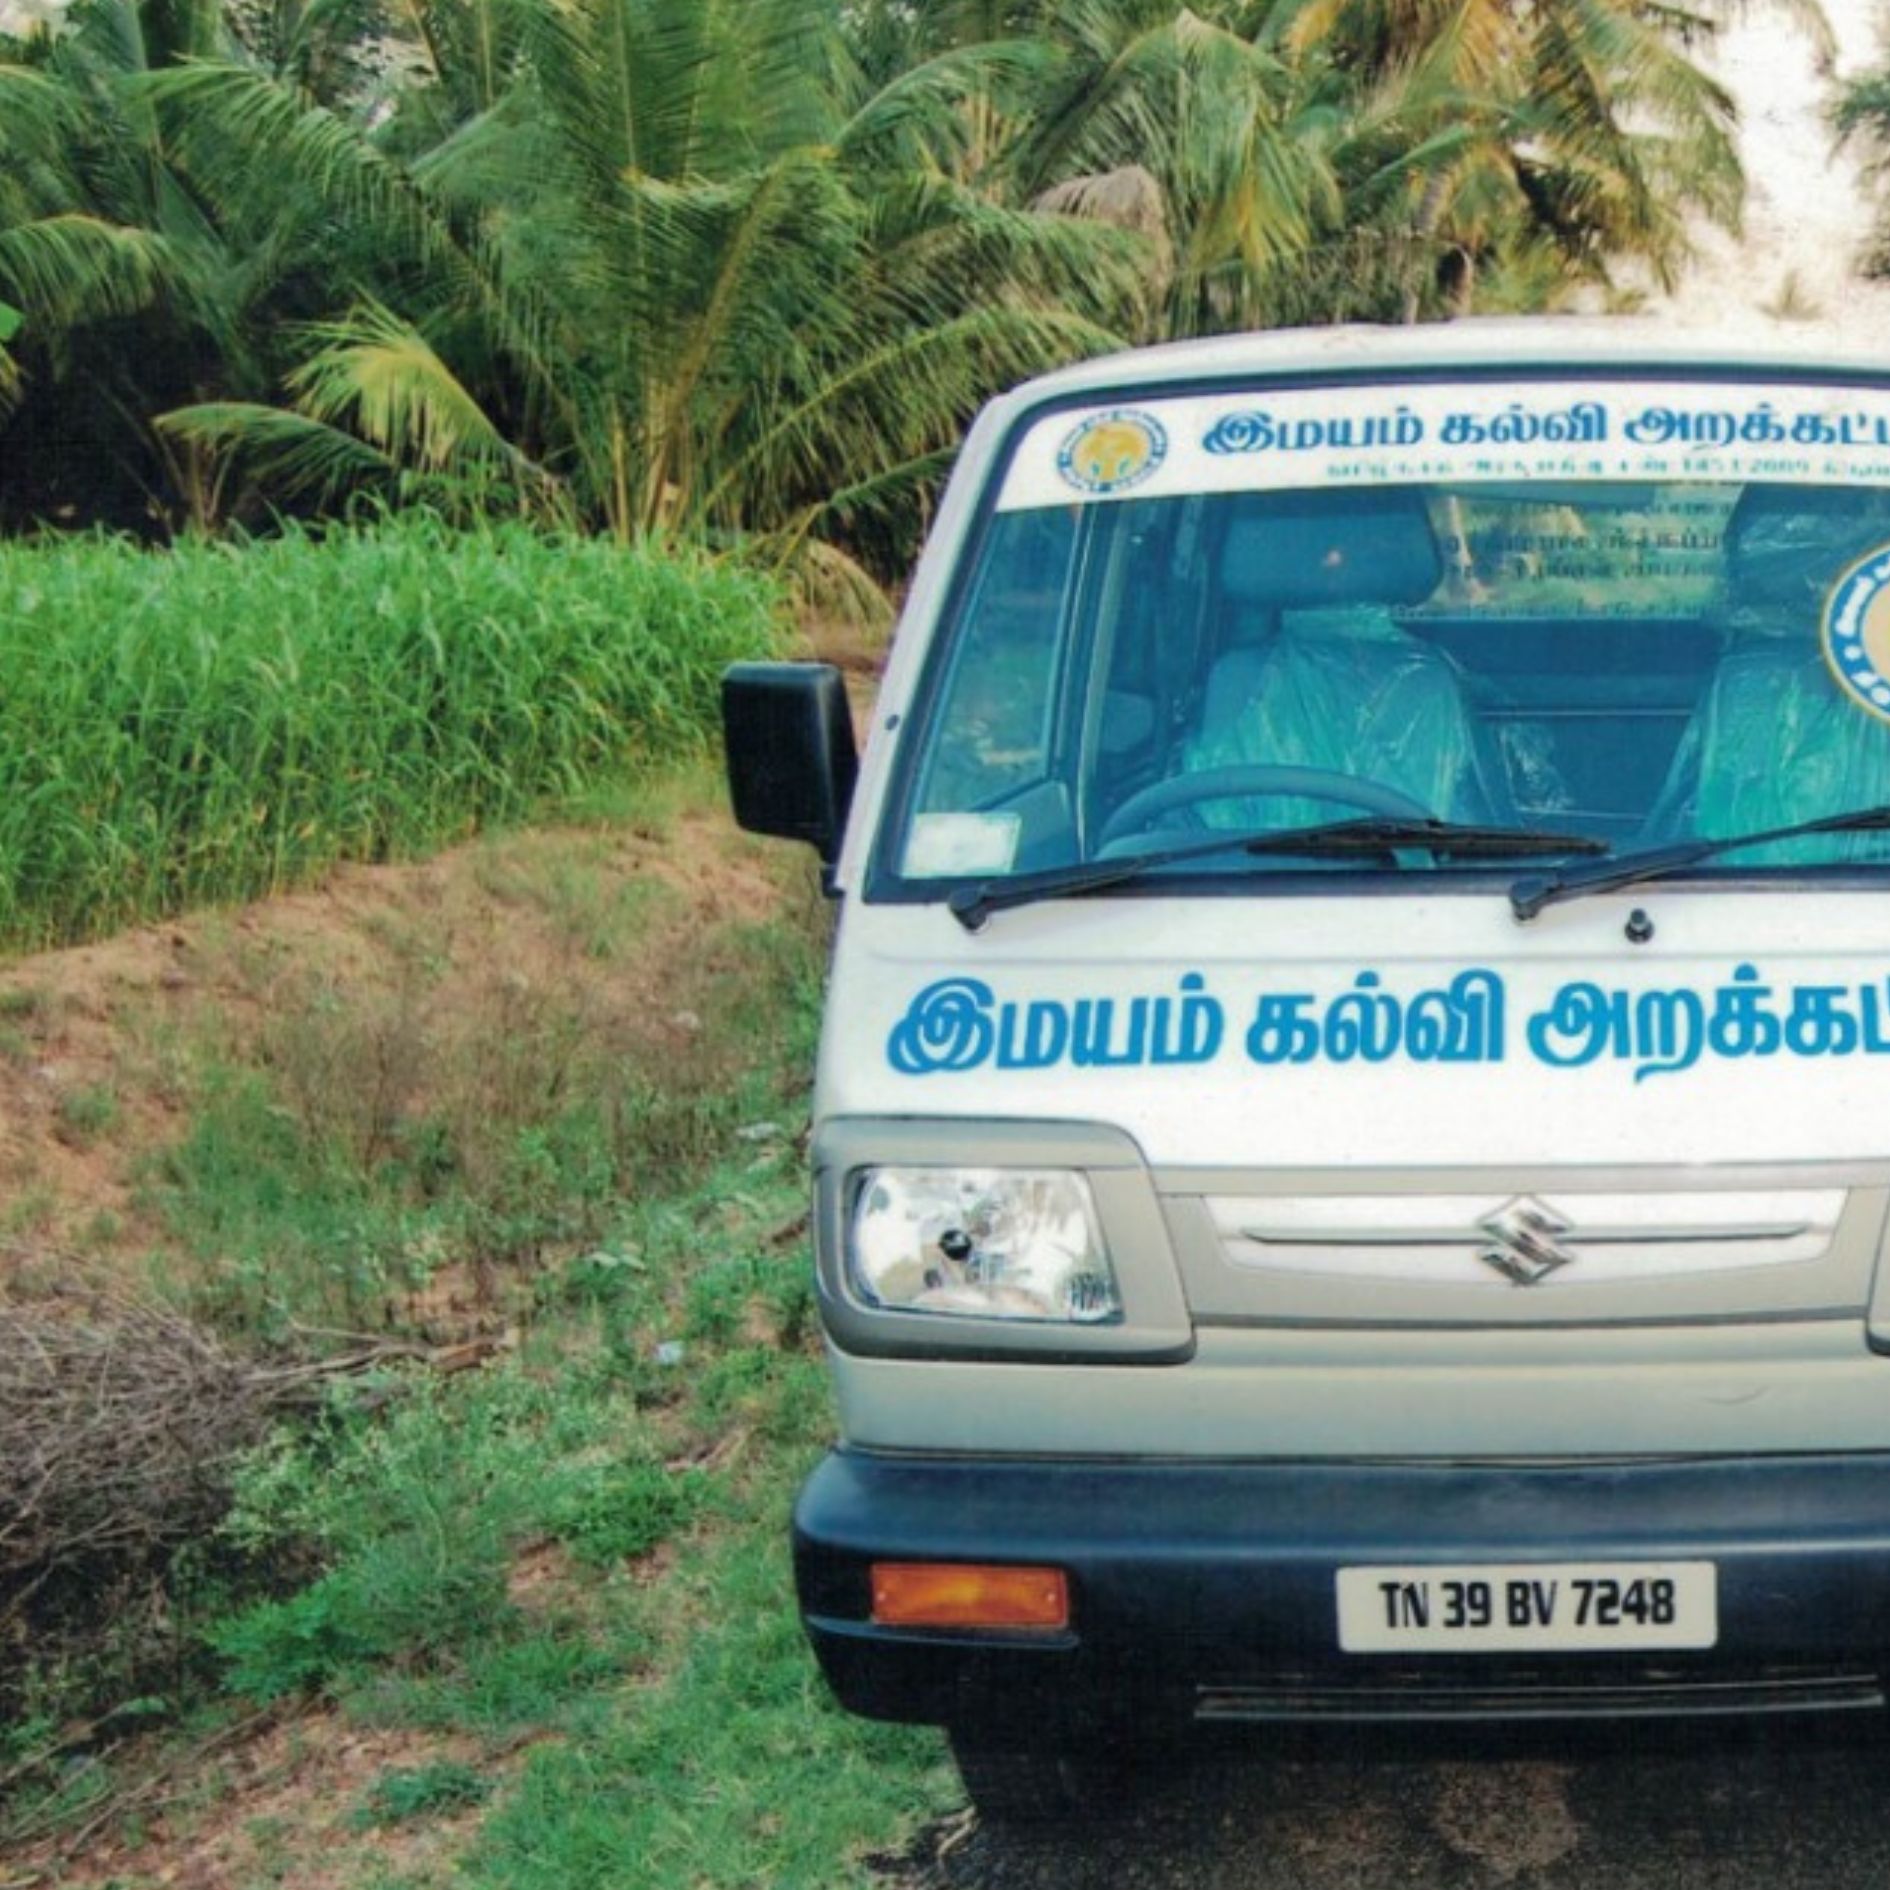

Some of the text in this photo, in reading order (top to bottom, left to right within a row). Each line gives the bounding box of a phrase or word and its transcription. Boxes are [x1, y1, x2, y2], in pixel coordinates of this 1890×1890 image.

[1202, 406, 1424, 455] இமயம்
[1439, 402, 1607, 446] கல்வி
[886, 973, 1225, 1075] இமயம்
[1245, 968, 1505, 1063] கல்வி
[1379, 1578, 1676, 1628] TN 39 BV 7248
